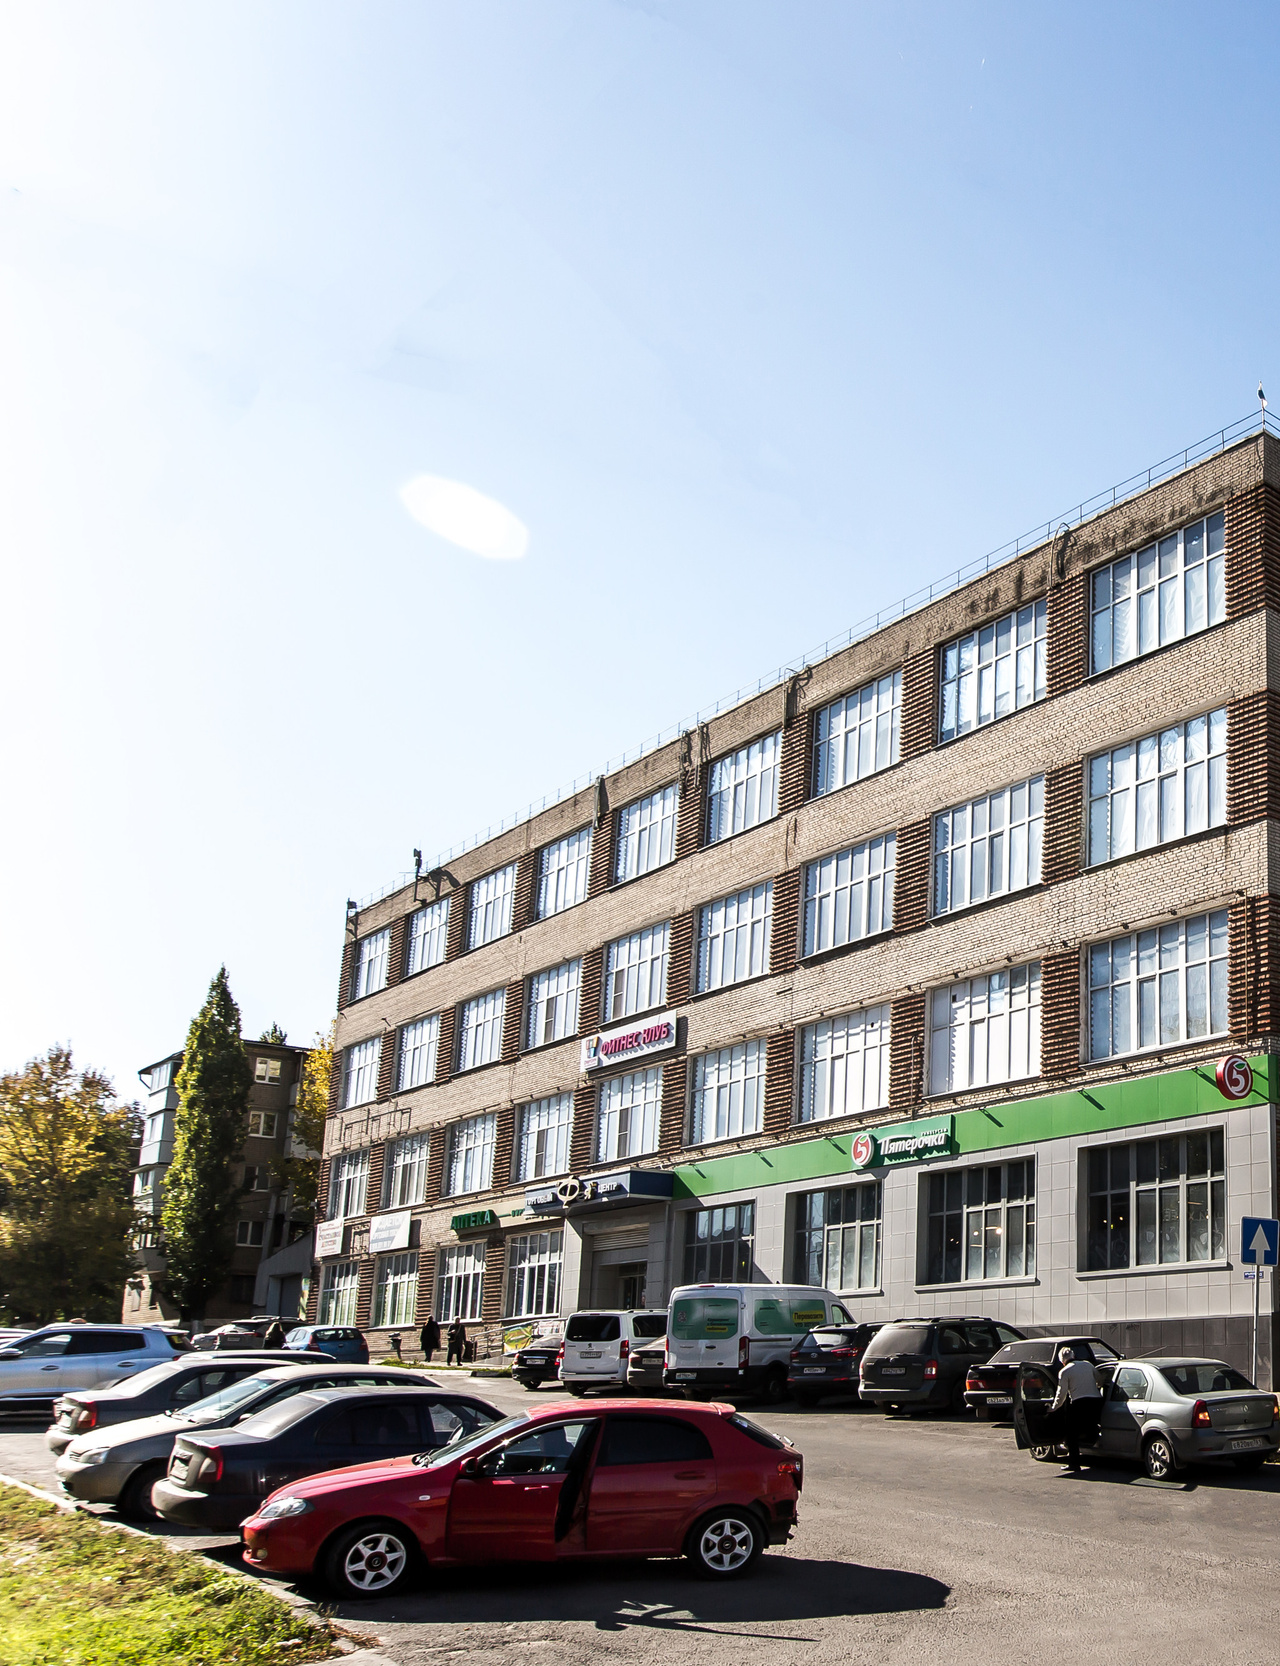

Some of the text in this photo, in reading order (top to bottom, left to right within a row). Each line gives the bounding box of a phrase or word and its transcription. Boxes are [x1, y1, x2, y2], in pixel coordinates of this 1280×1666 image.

[600, 1022, 671, 1056] ФИТНЕС КЛУБ
[877, 1134, 947, 1155] Пятерочка
[598, 1182, 618, 1194] ЦЕНТР
[450, 1209, 493, 1230] АПТЕКА
